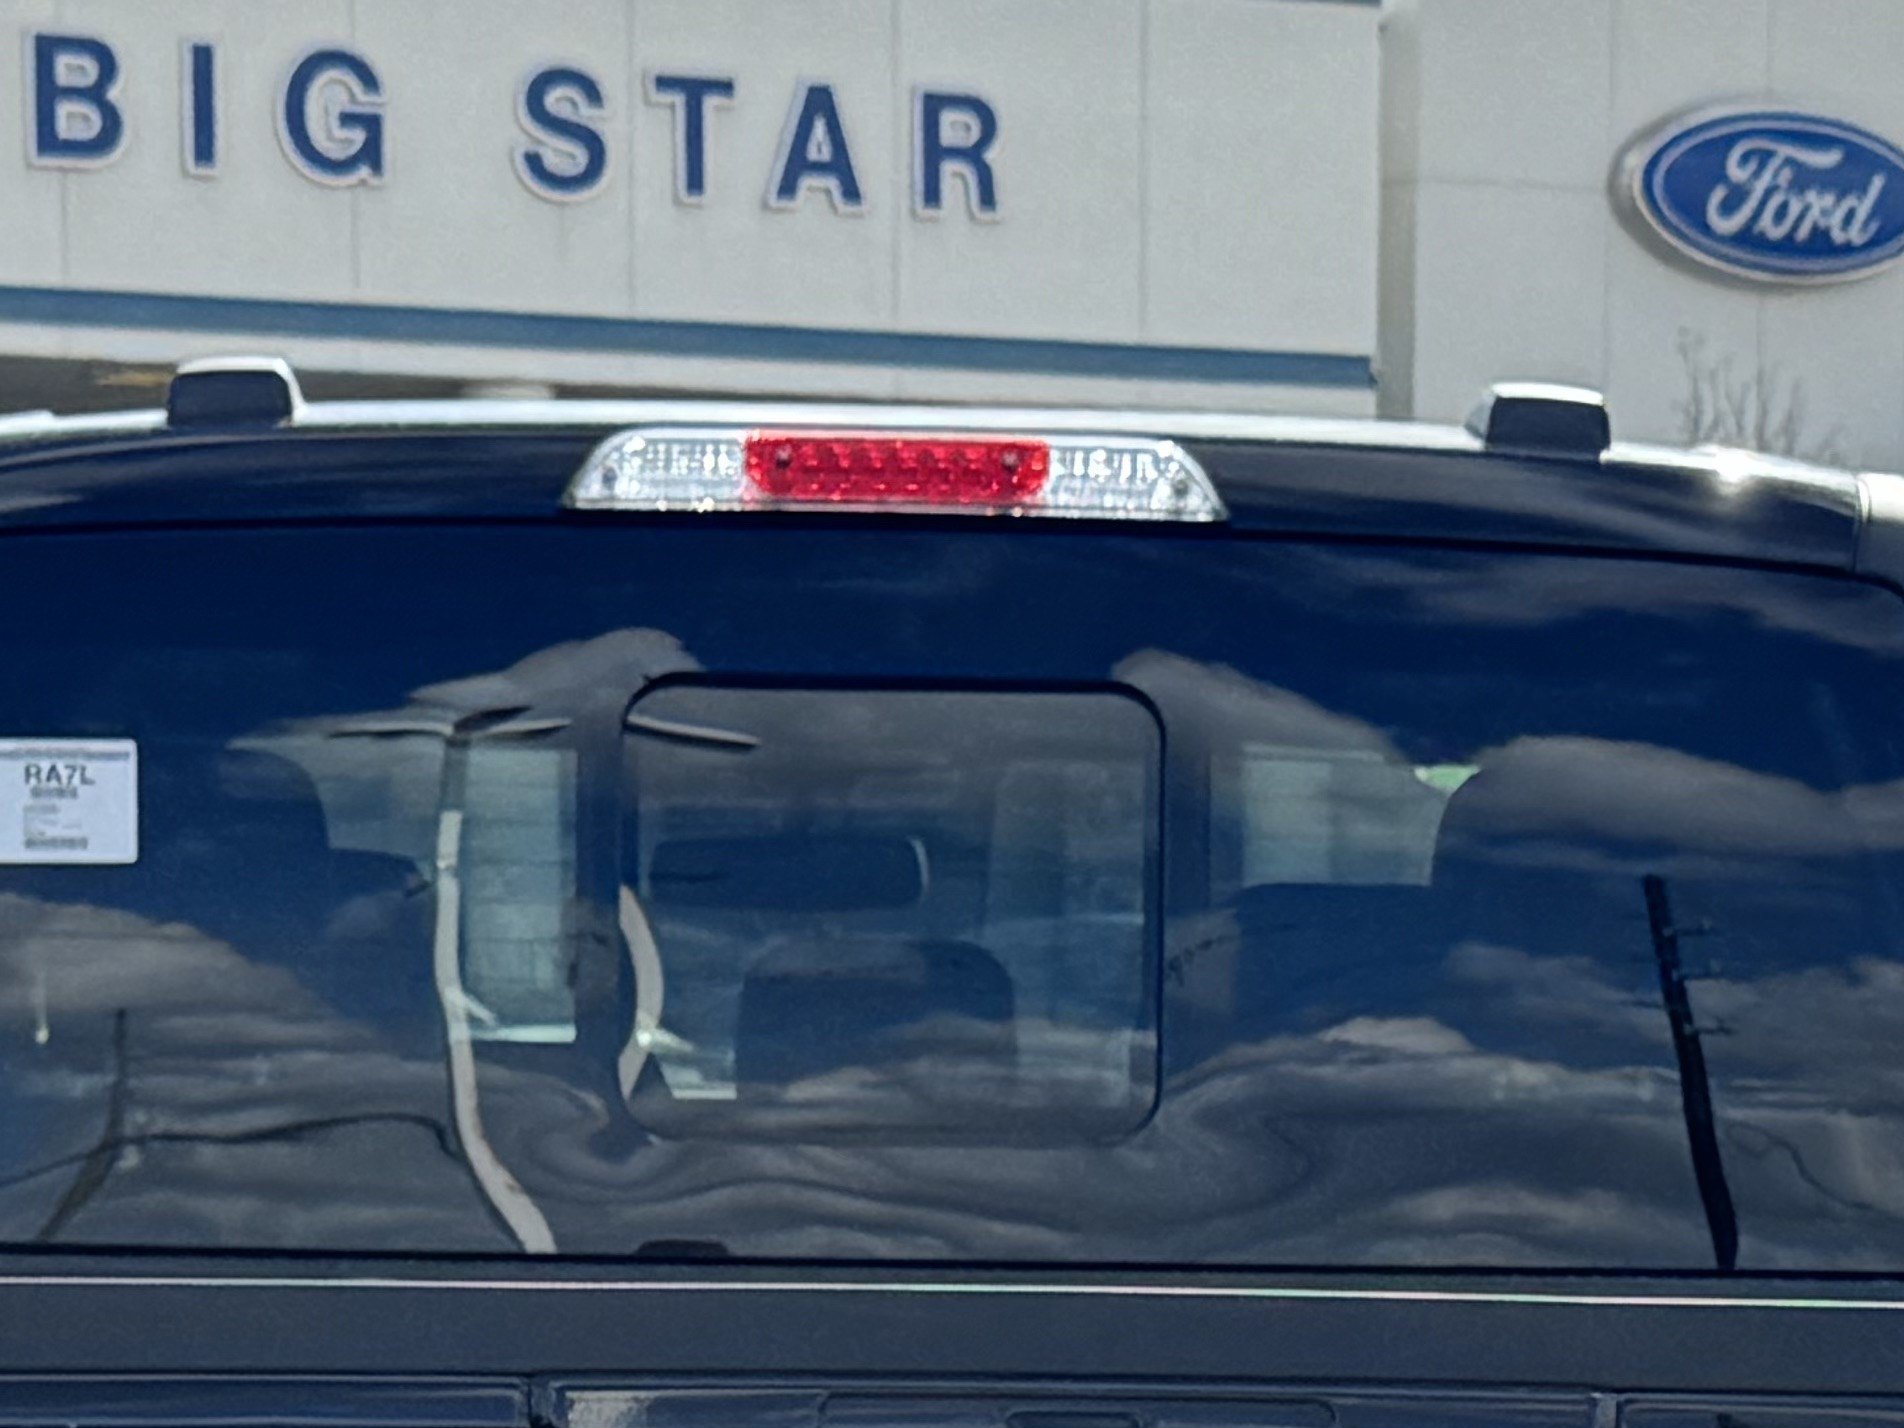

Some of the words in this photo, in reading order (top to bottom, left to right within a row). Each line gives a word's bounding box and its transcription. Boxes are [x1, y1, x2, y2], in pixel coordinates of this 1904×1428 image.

[31, 32, 387, 182] BIG
[516, 66, 1002, 217] STAR
[1705, 137, 1886, 247] Ford
[23, 763, 96, 786] RA7L
